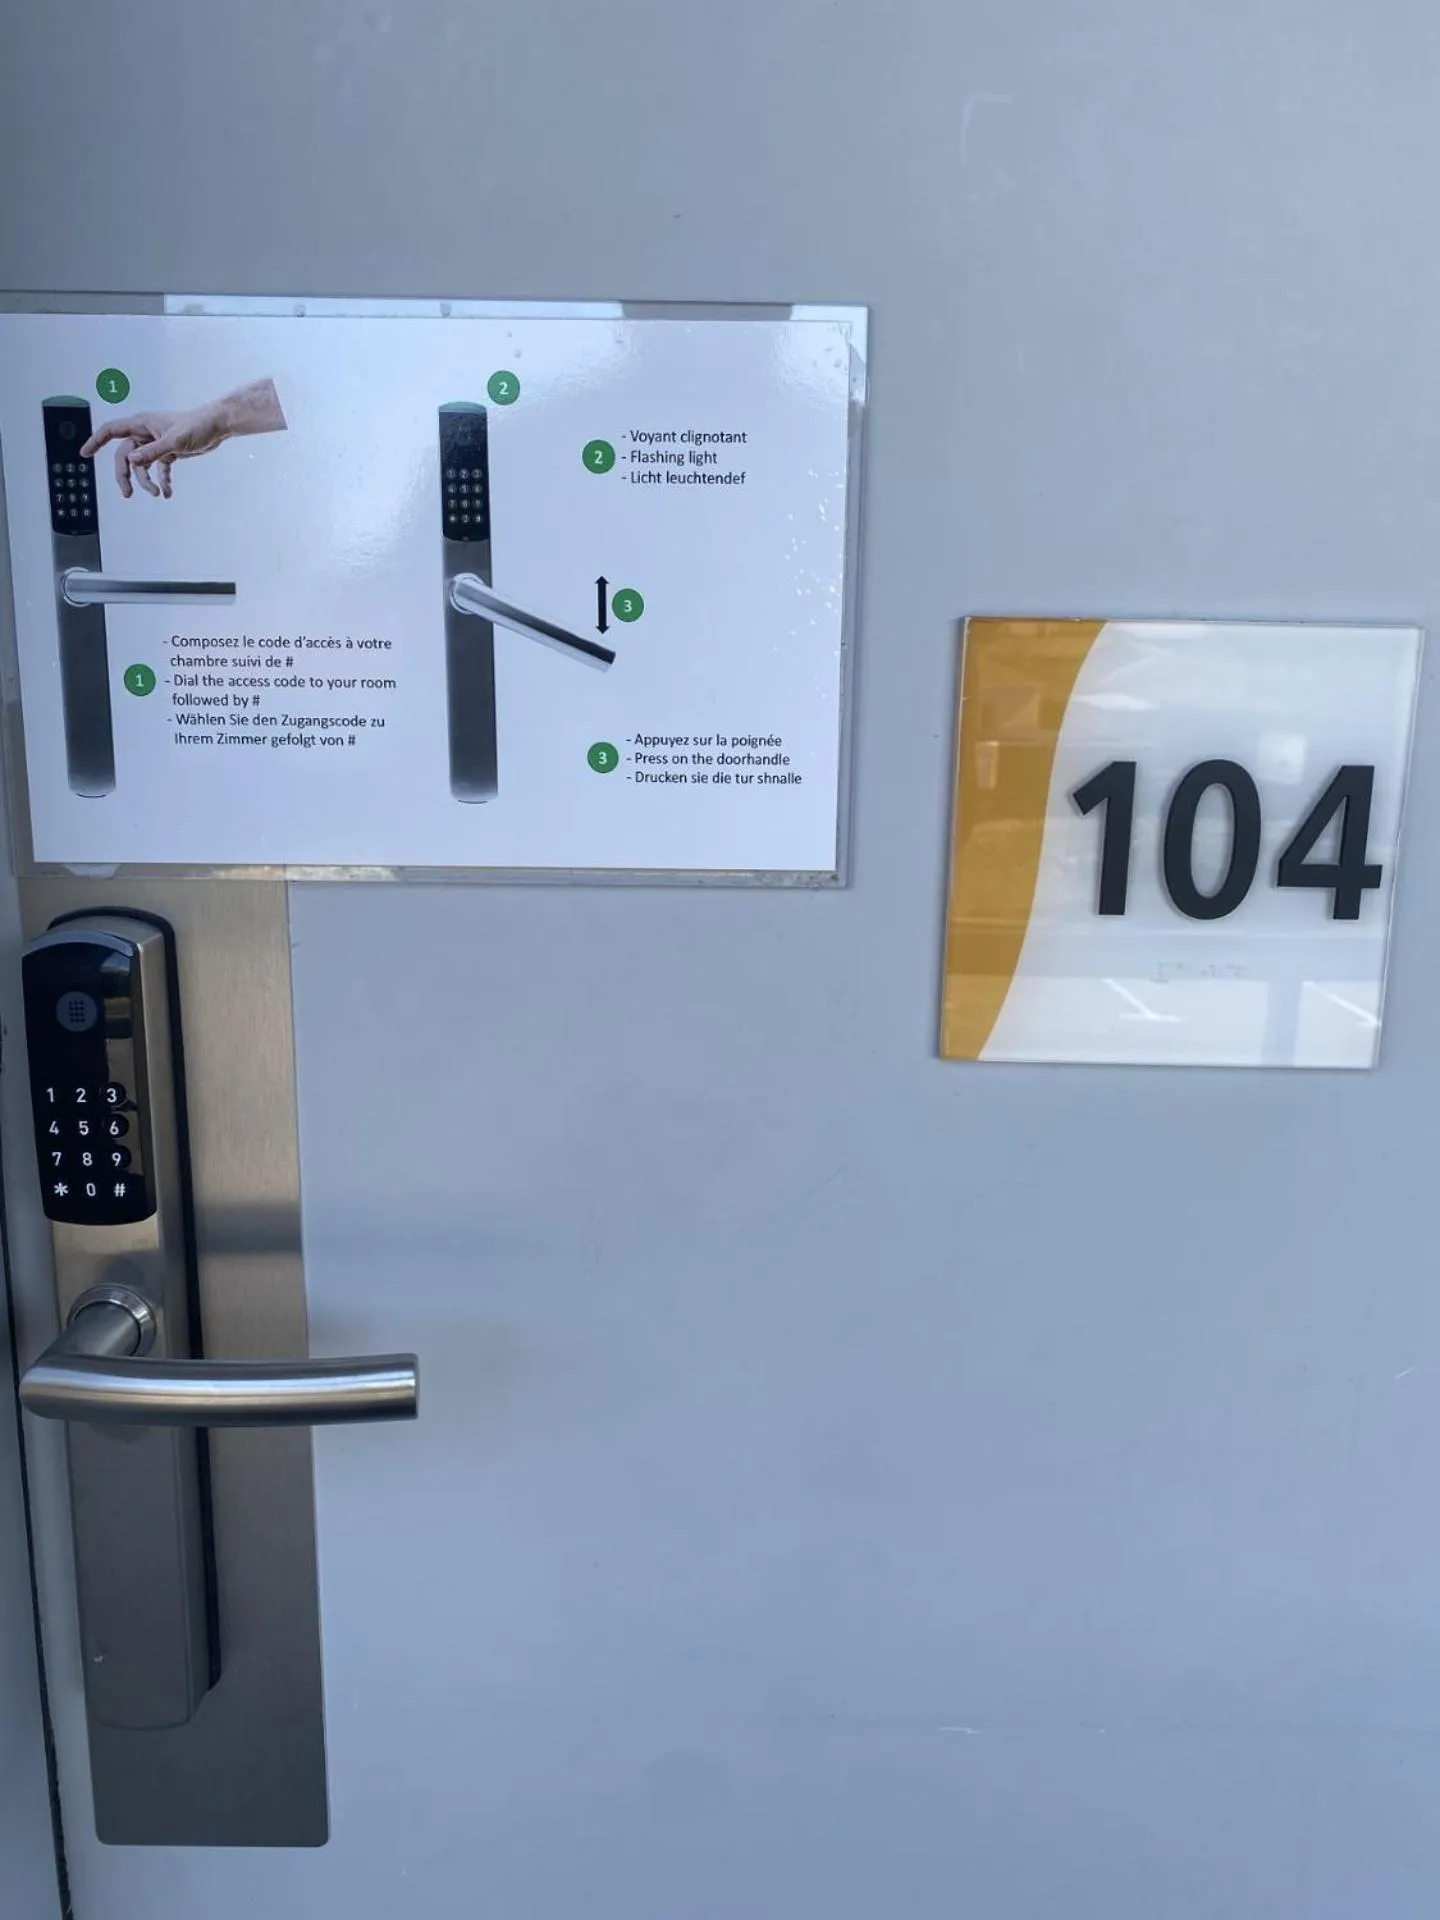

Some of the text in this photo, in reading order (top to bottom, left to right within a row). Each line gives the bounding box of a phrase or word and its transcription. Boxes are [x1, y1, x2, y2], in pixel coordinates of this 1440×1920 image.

[109, 379, 118, 393] 1
[498, 381, 509, 395] 2
[630, 430, 677, 446] Voyant
[680, 430, 748, 447] clignotant
[593, 450, 603, 465] 2
[631, 449, 684, 466] Flashing
[689, 450, 717, 467] light
[631, 470, 663, 484] Licht
[666, 470, 746, 485] leuchtendef
[623, 599, 632, 612] 3
[171, 635, 239, 650] Composez
[243, 635, 255, 648] le
[258, 636, 290, 648] code
[346, 636, 353, 649] à
[357, 638, 392, 650] votre
[170, 654, 294, 668] chambre suivi de #
[135, 674, 145, 687] 1
[174, 674, 198, 686] Dial
[202, 674, 224, 686] the
[228, 677, 270, 687] access
[274, 675, 305, 688] code
[309, 677, 323, 688] to
[327, 679, 357, 690] your
[361, 679, 396, 689] room
[172, 693, 260, 709] followed by #
[176, 713, 226, 726] Wählen
[229, 714, 249, 726] Sie
[252, 713, 277, 726] den
[281, 714, 367, 729] Zugangscode
[371, 718, 385, 727] zu
[175, 732, 356, 748] Ihrem Zimmer gefolgt von #
[634, 733, 689, 748] Appuyez
[693, 737, 713, 746] sur
[716, 733, 727, 746] la
[731, 734, 782, 749] poignée
[598, 752, 607, 765] 3
[635, 752, 668, 766] Press
[672, 755, 688, 765] on
[691, 752, 713, 765] the
[717, 752, 790, 766] doorhandle
[635, 771, 687, 784] Drucken
[691, 772, 708, 784] sie
[712, 771, 731, 784] die
[735, 773, 755, 784] tur
[757, 772, 802, 784] shnalle
[1071, 758, 1383, 921] 104
[46, 1087, 118, 1103] 1 2 3
[48, 1120, 120, 1136] 4 5 6
[51, 1151, 122, 1167] 7 8 9
[86, 1182, 97, 1197] 0
[113, 1182, 126, 1197] #
